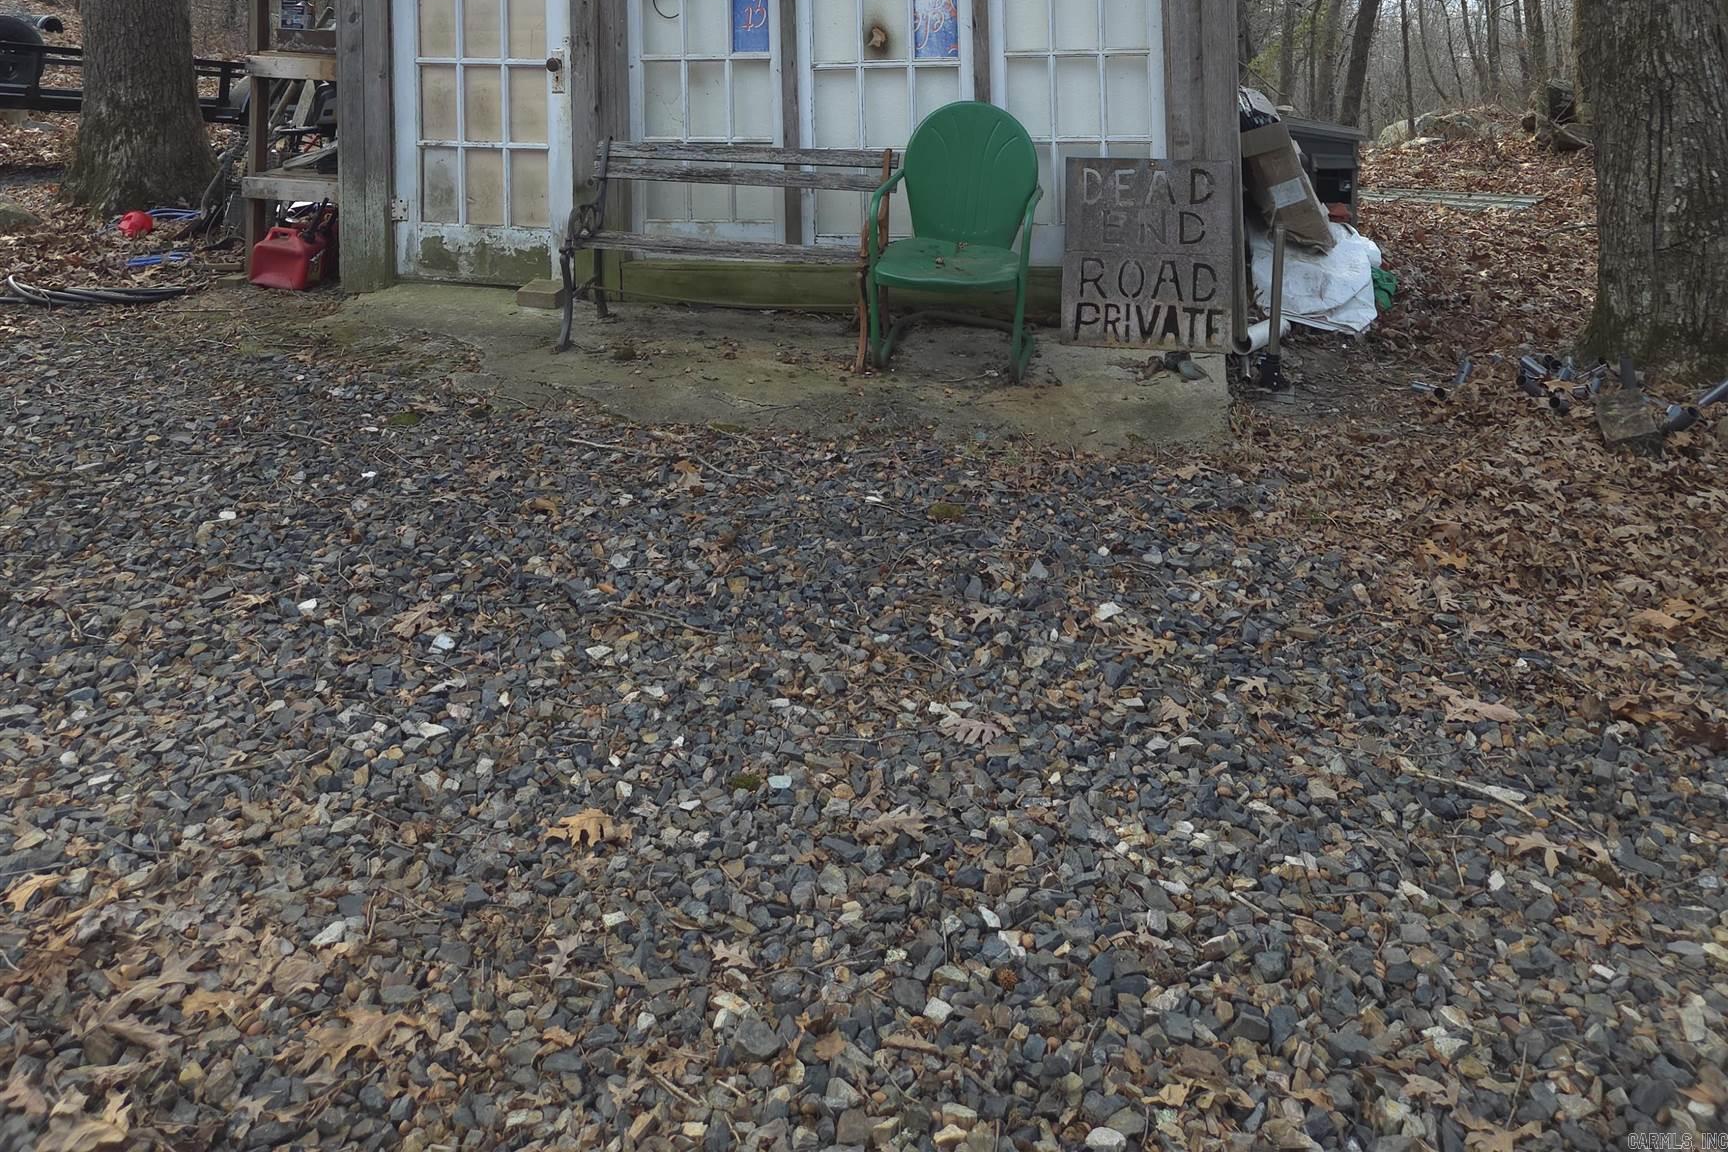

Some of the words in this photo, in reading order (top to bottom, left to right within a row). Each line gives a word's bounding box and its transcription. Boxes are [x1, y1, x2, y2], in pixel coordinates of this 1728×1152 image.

[1083, 167, 1215, 206] DEAD
[1102, 209, 1206, 246] END
[1080, 257, 1218, 302] ROAD
[1074, 302, 1225, 348] PRIVATE
